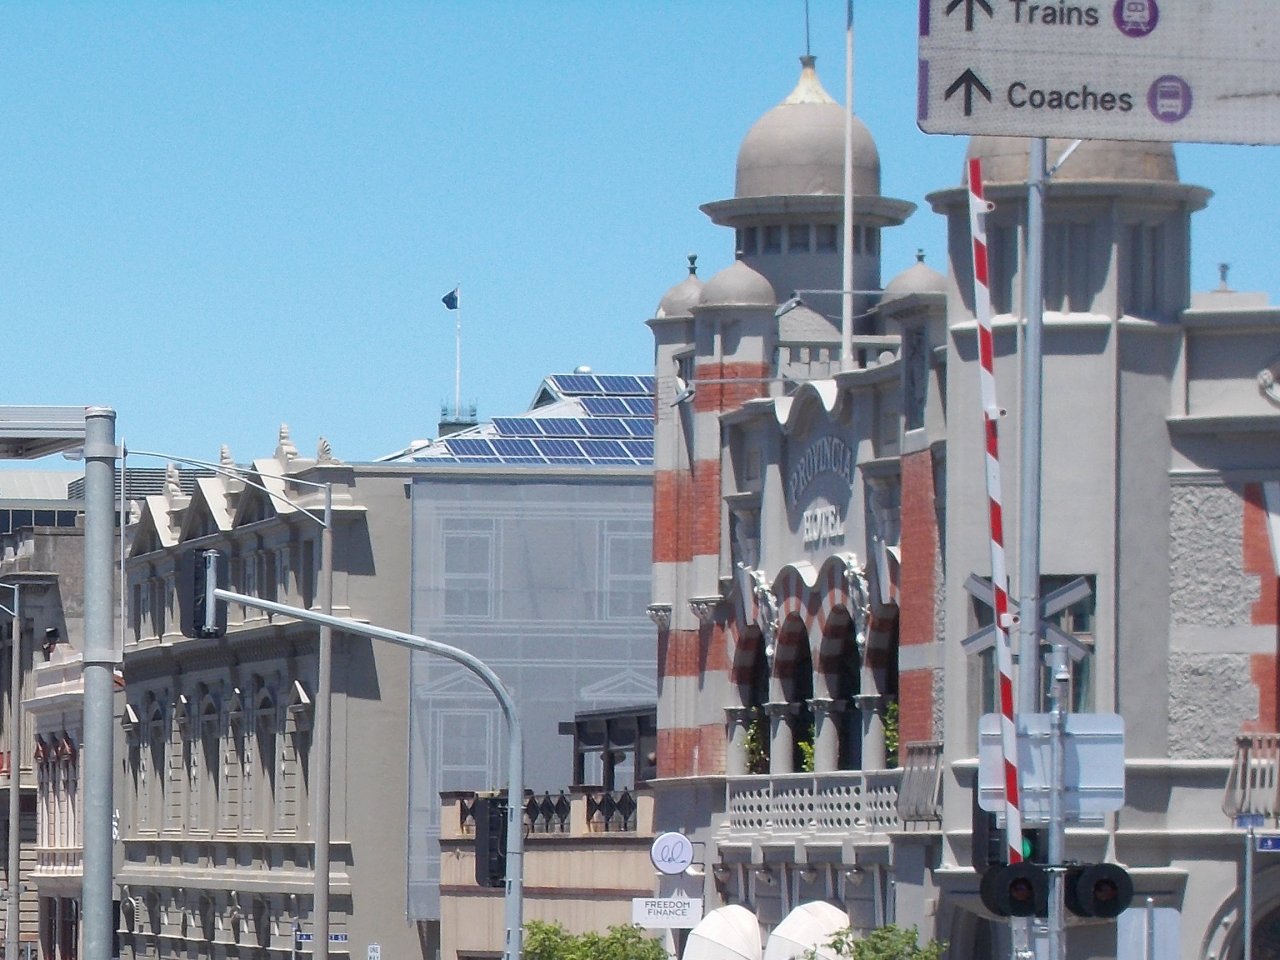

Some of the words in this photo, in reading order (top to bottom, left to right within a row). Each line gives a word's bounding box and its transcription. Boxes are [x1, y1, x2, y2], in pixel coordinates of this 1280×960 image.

[1009, 0, 1099, 26] Trains
[1007, 81, 1133, 112] Coaches
[803, 505, 845, 542] HOTEL
[645, 901, 691, 909] FREEDOM
[648, 909, 688, 917] FINANCE
